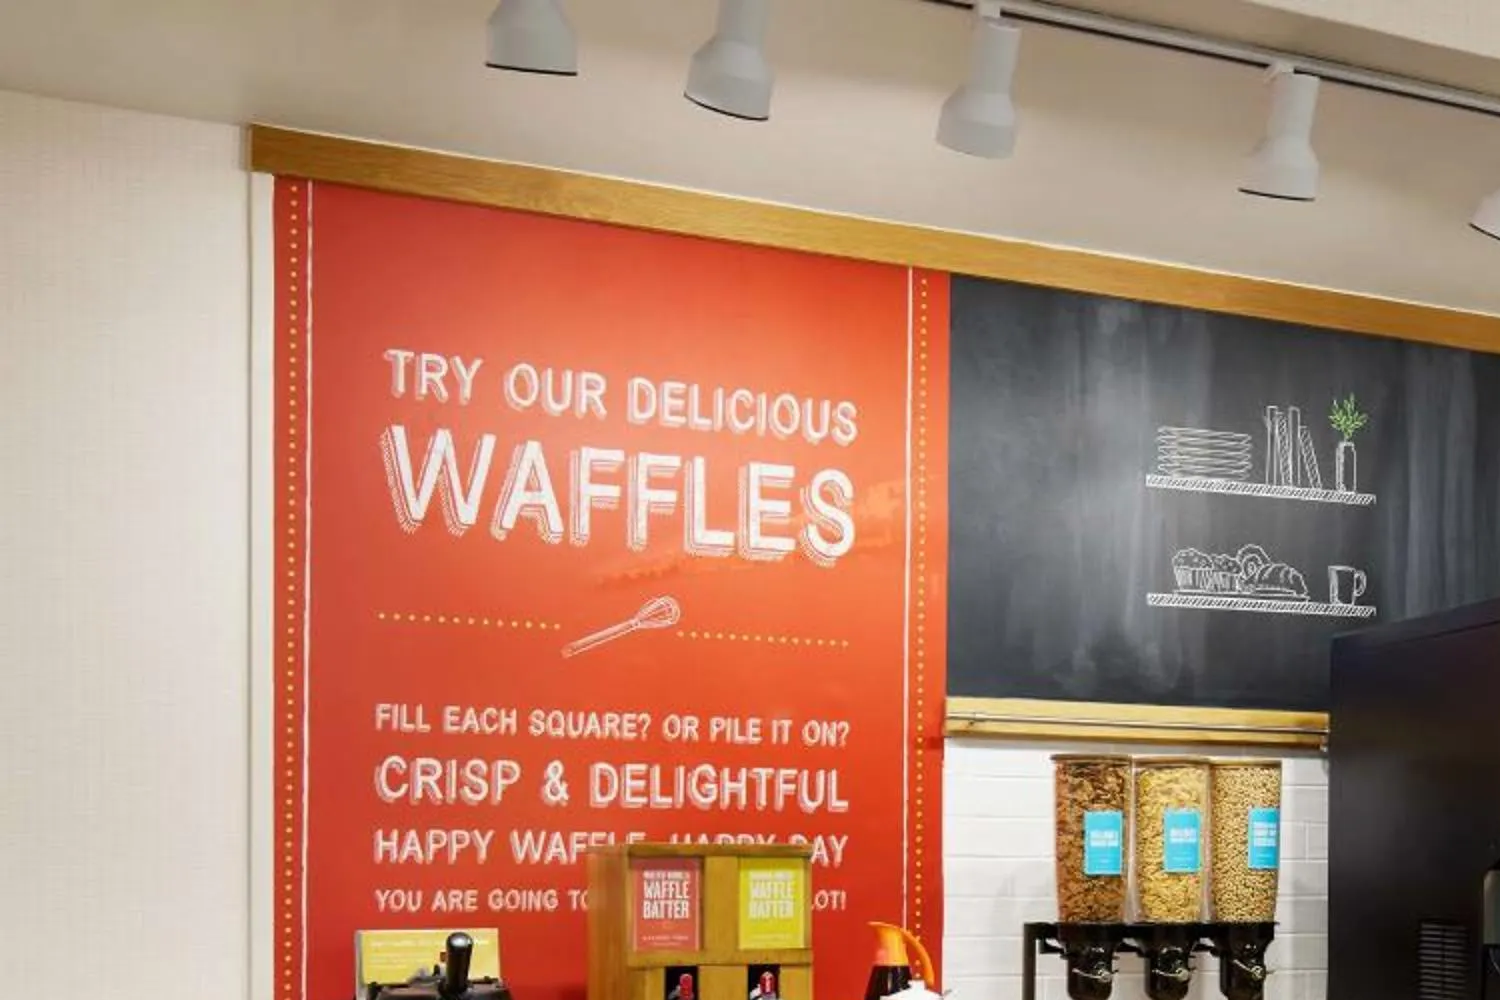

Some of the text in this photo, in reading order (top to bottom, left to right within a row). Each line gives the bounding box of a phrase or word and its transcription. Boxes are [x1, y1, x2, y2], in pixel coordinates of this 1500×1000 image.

[384, 348, 858, 447] TRY OUR DELICIOUS
[380, 424, 855, 568] WAFFLES
[375, 703, 850, 747] FILL EACH SQUARE? OR PILE IT ON?
[374, 755, 849, 813] CRISP & DELIGHTFUL
[374, 828, 496, 865] HAPPY
[375, 888, 422, 912] YOU
[431, 889, 478, 912] ARE
[488, 889, 558, 911] GOING
[811, 889, 846, 911] OT!
[643, 880, 690, 899] WAFFLE
[750, 881, 795, 899] WAFFLE
[643, 899, 689, 919] BATTER
[749, 899, 794, 919] BATTER
